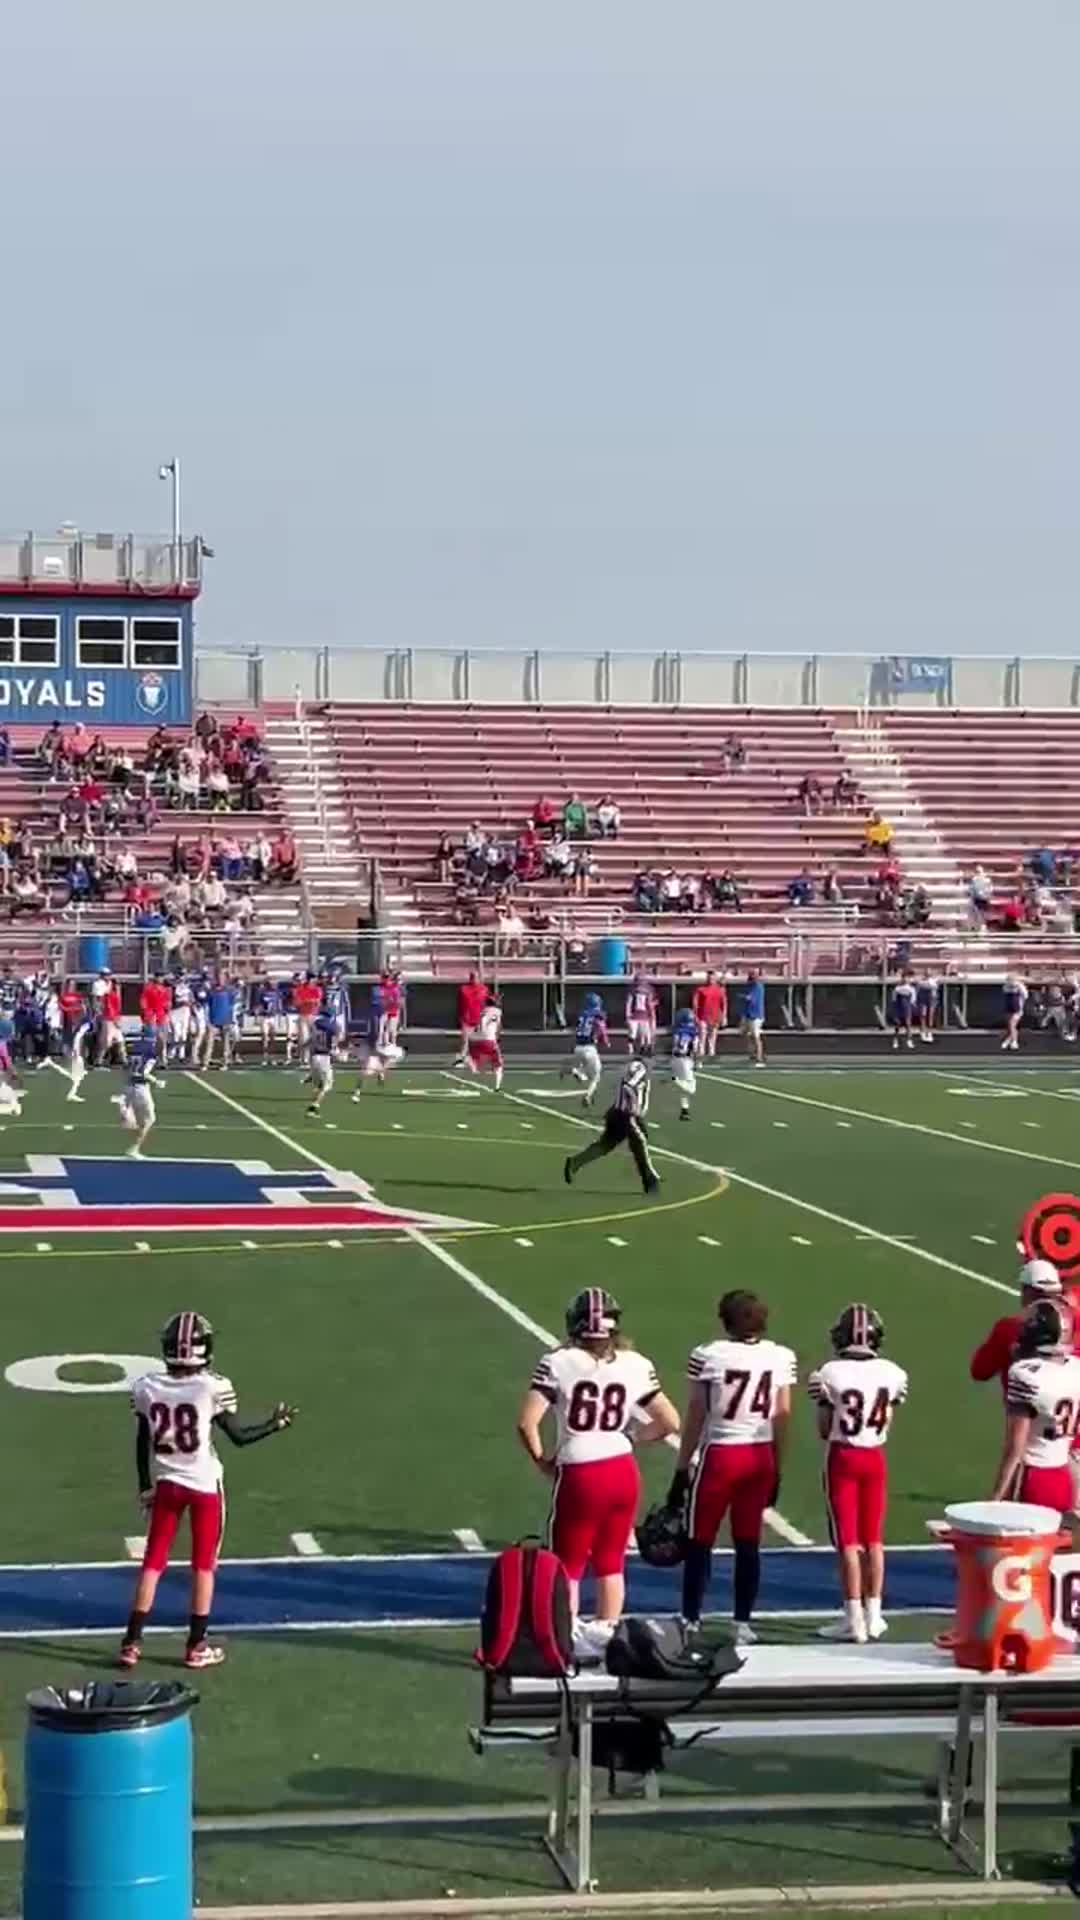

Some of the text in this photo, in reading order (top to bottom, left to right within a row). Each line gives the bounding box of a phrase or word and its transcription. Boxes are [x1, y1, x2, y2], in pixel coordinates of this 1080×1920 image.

[567, 1381, 627, 1432] 68
[723, 1370, 773, 1420] 74
[838, 1387, 890, 1436] 34
[150, 1402, 200, 1454] 28
[992, 1555, 1033, 1602] G
